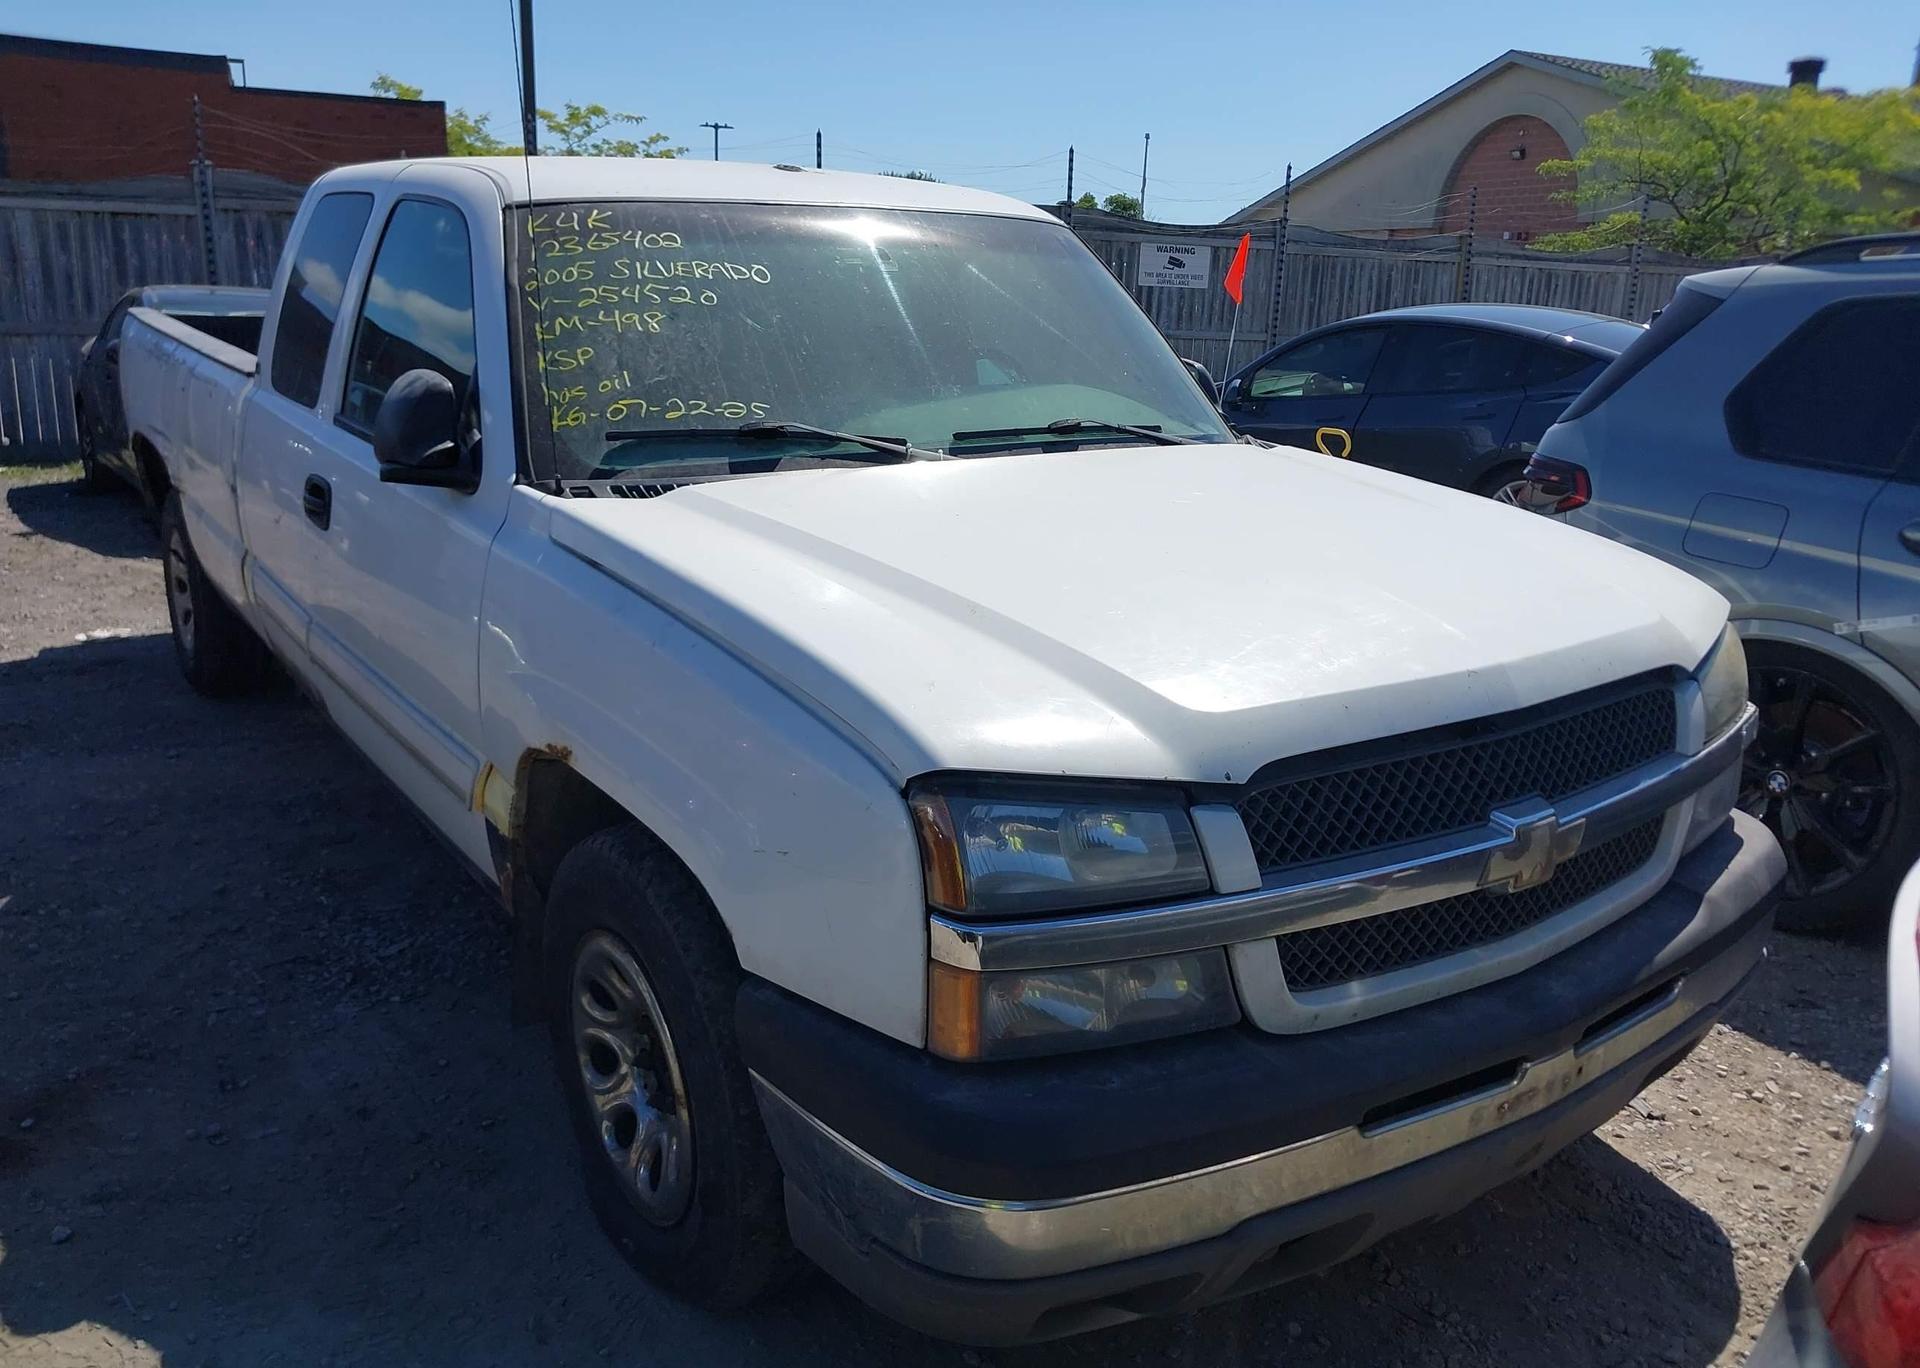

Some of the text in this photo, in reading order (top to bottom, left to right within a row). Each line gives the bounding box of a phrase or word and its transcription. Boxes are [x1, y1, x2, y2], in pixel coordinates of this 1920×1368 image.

[1156, 244, 1196, 255] WARNING
[525, 258, 771, 291] 2005 SILVERADO
[1144, 271, 1154, 279] THIS
[1156, 279, 1190, 287] SURVEILLANCE
[535, 310, 666, 340] KM-498
[599, 370, 631, 393] oil
